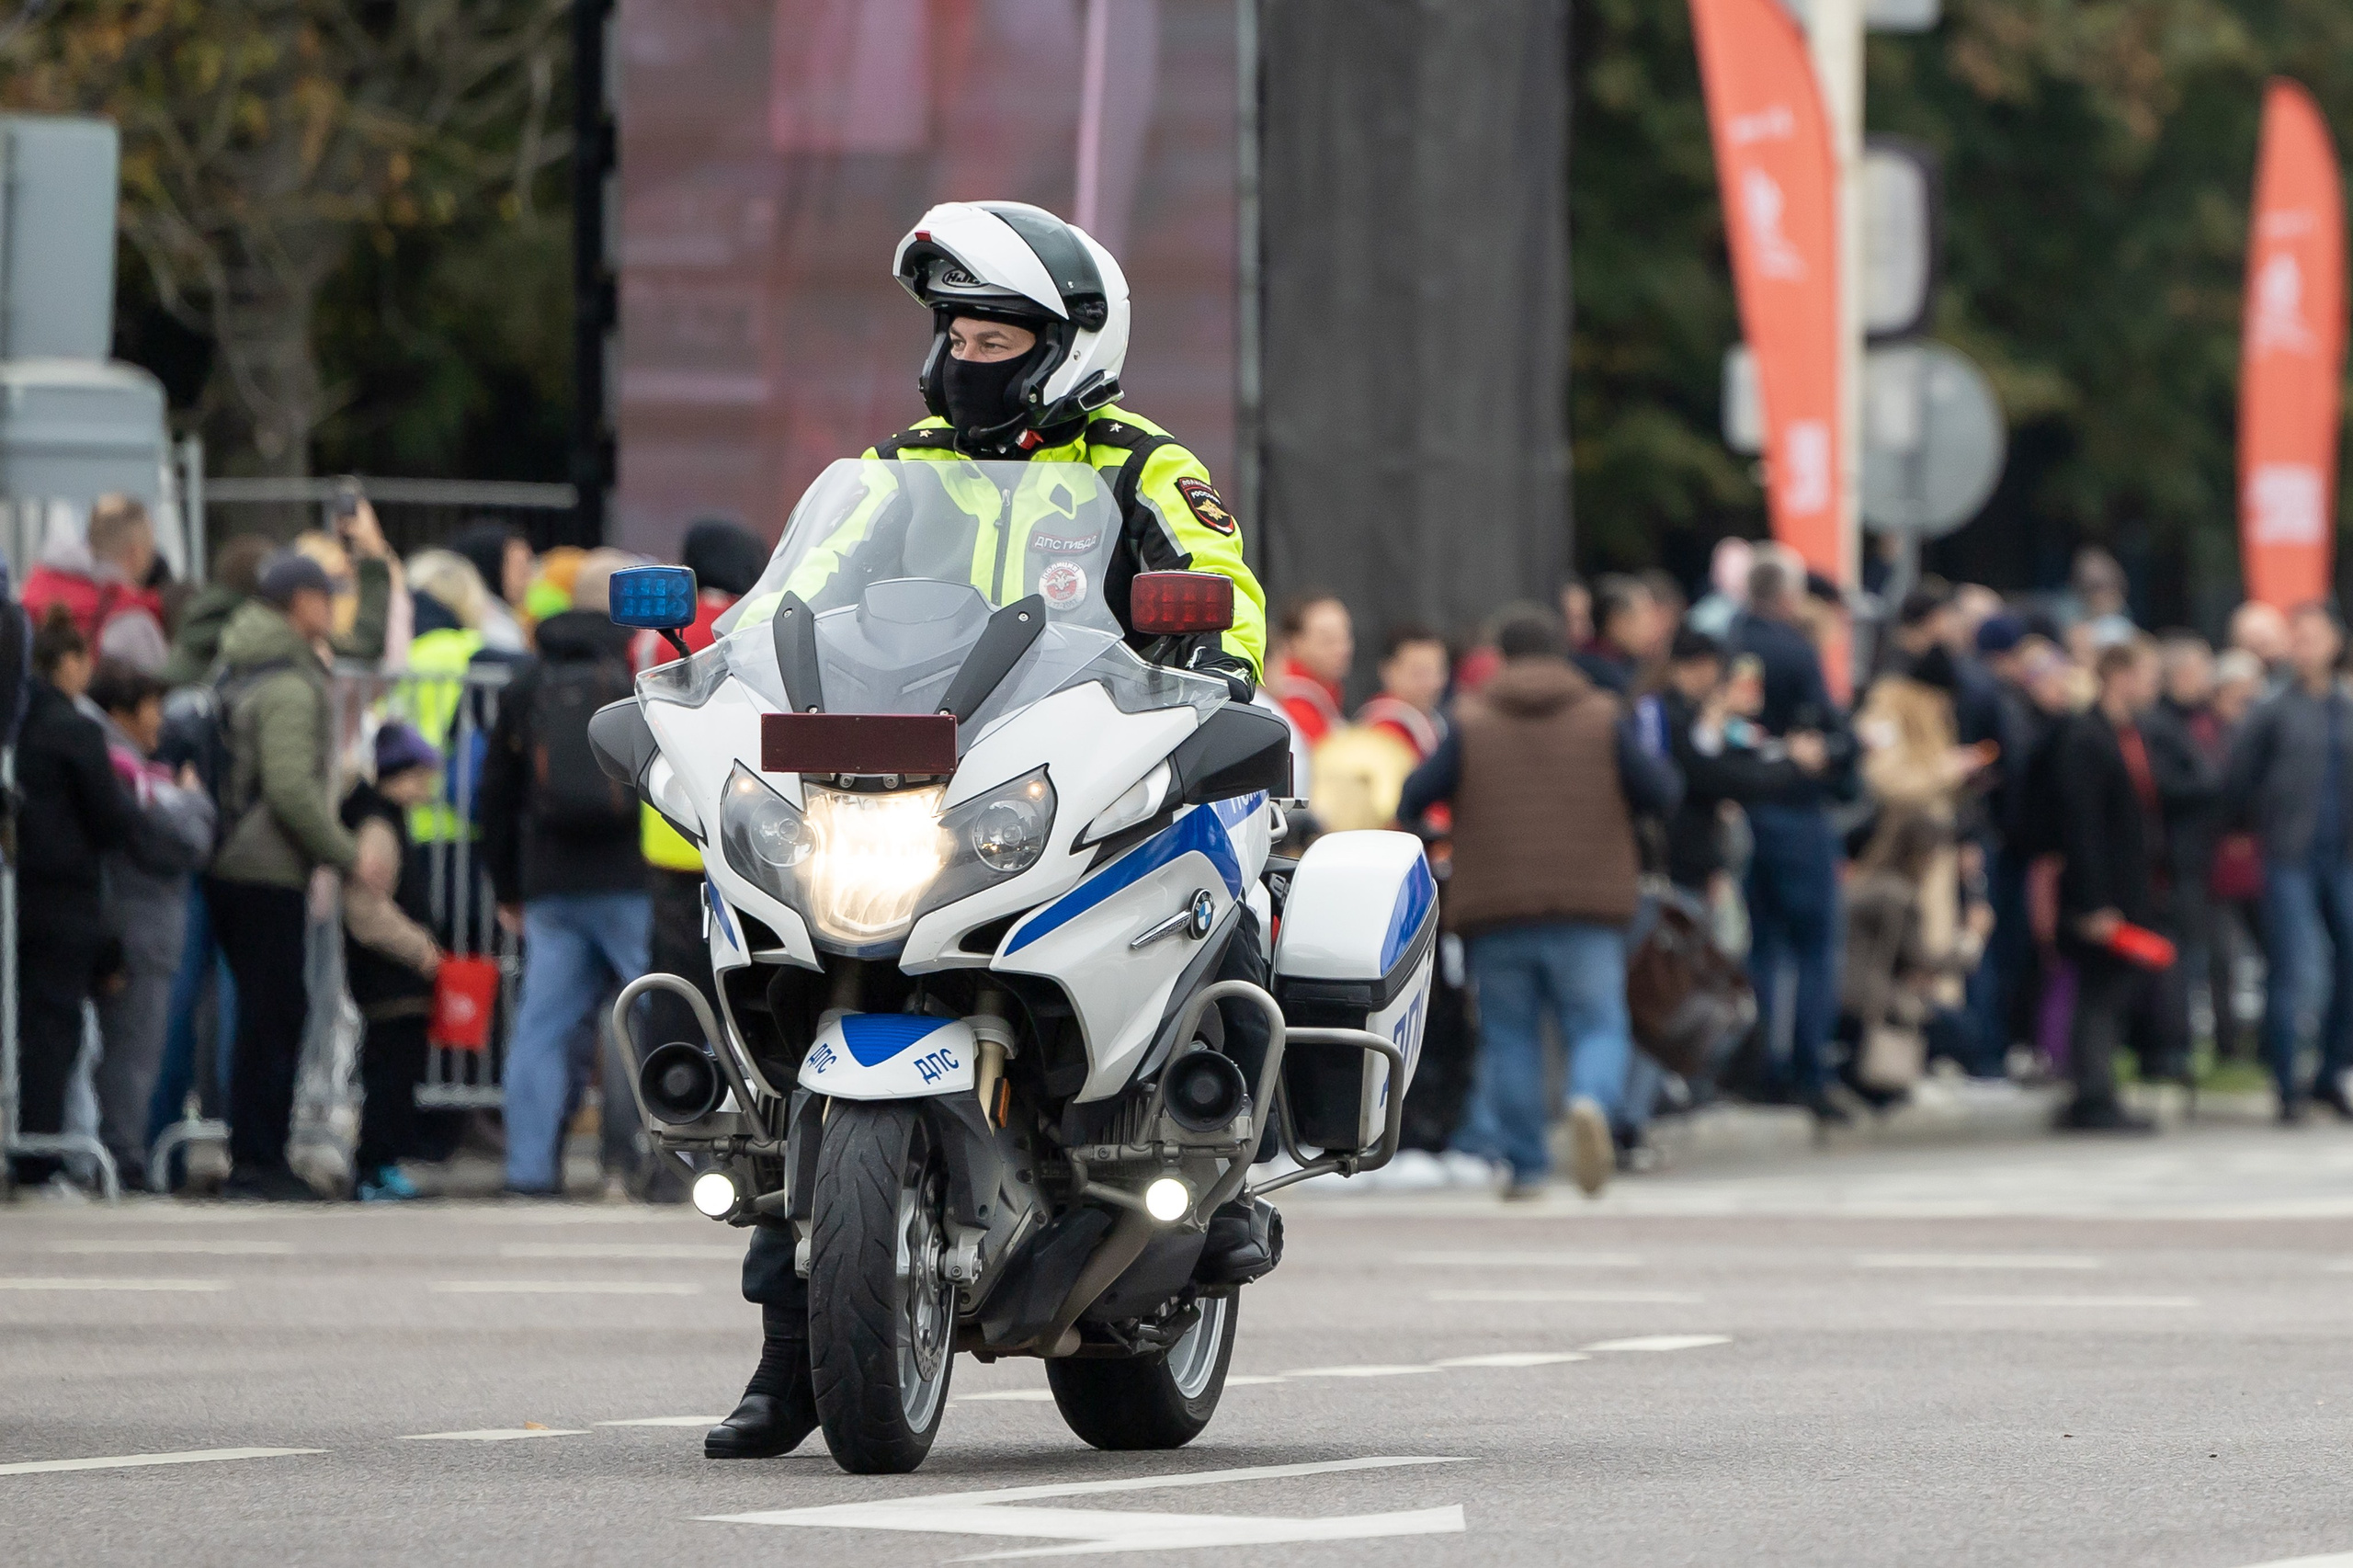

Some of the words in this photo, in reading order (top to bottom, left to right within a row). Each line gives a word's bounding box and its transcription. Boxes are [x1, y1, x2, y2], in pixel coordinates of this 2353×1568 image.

[1034, 536, 1062, 550] ДПС
[1063, 535, 1097, 550] ГИБДД
[1041, 562, 1081, 580] ПОЛИЦИЯ
[807, 1043, 837, 1074] ДПС
[913, 1048, 960, 1085] ДПС
